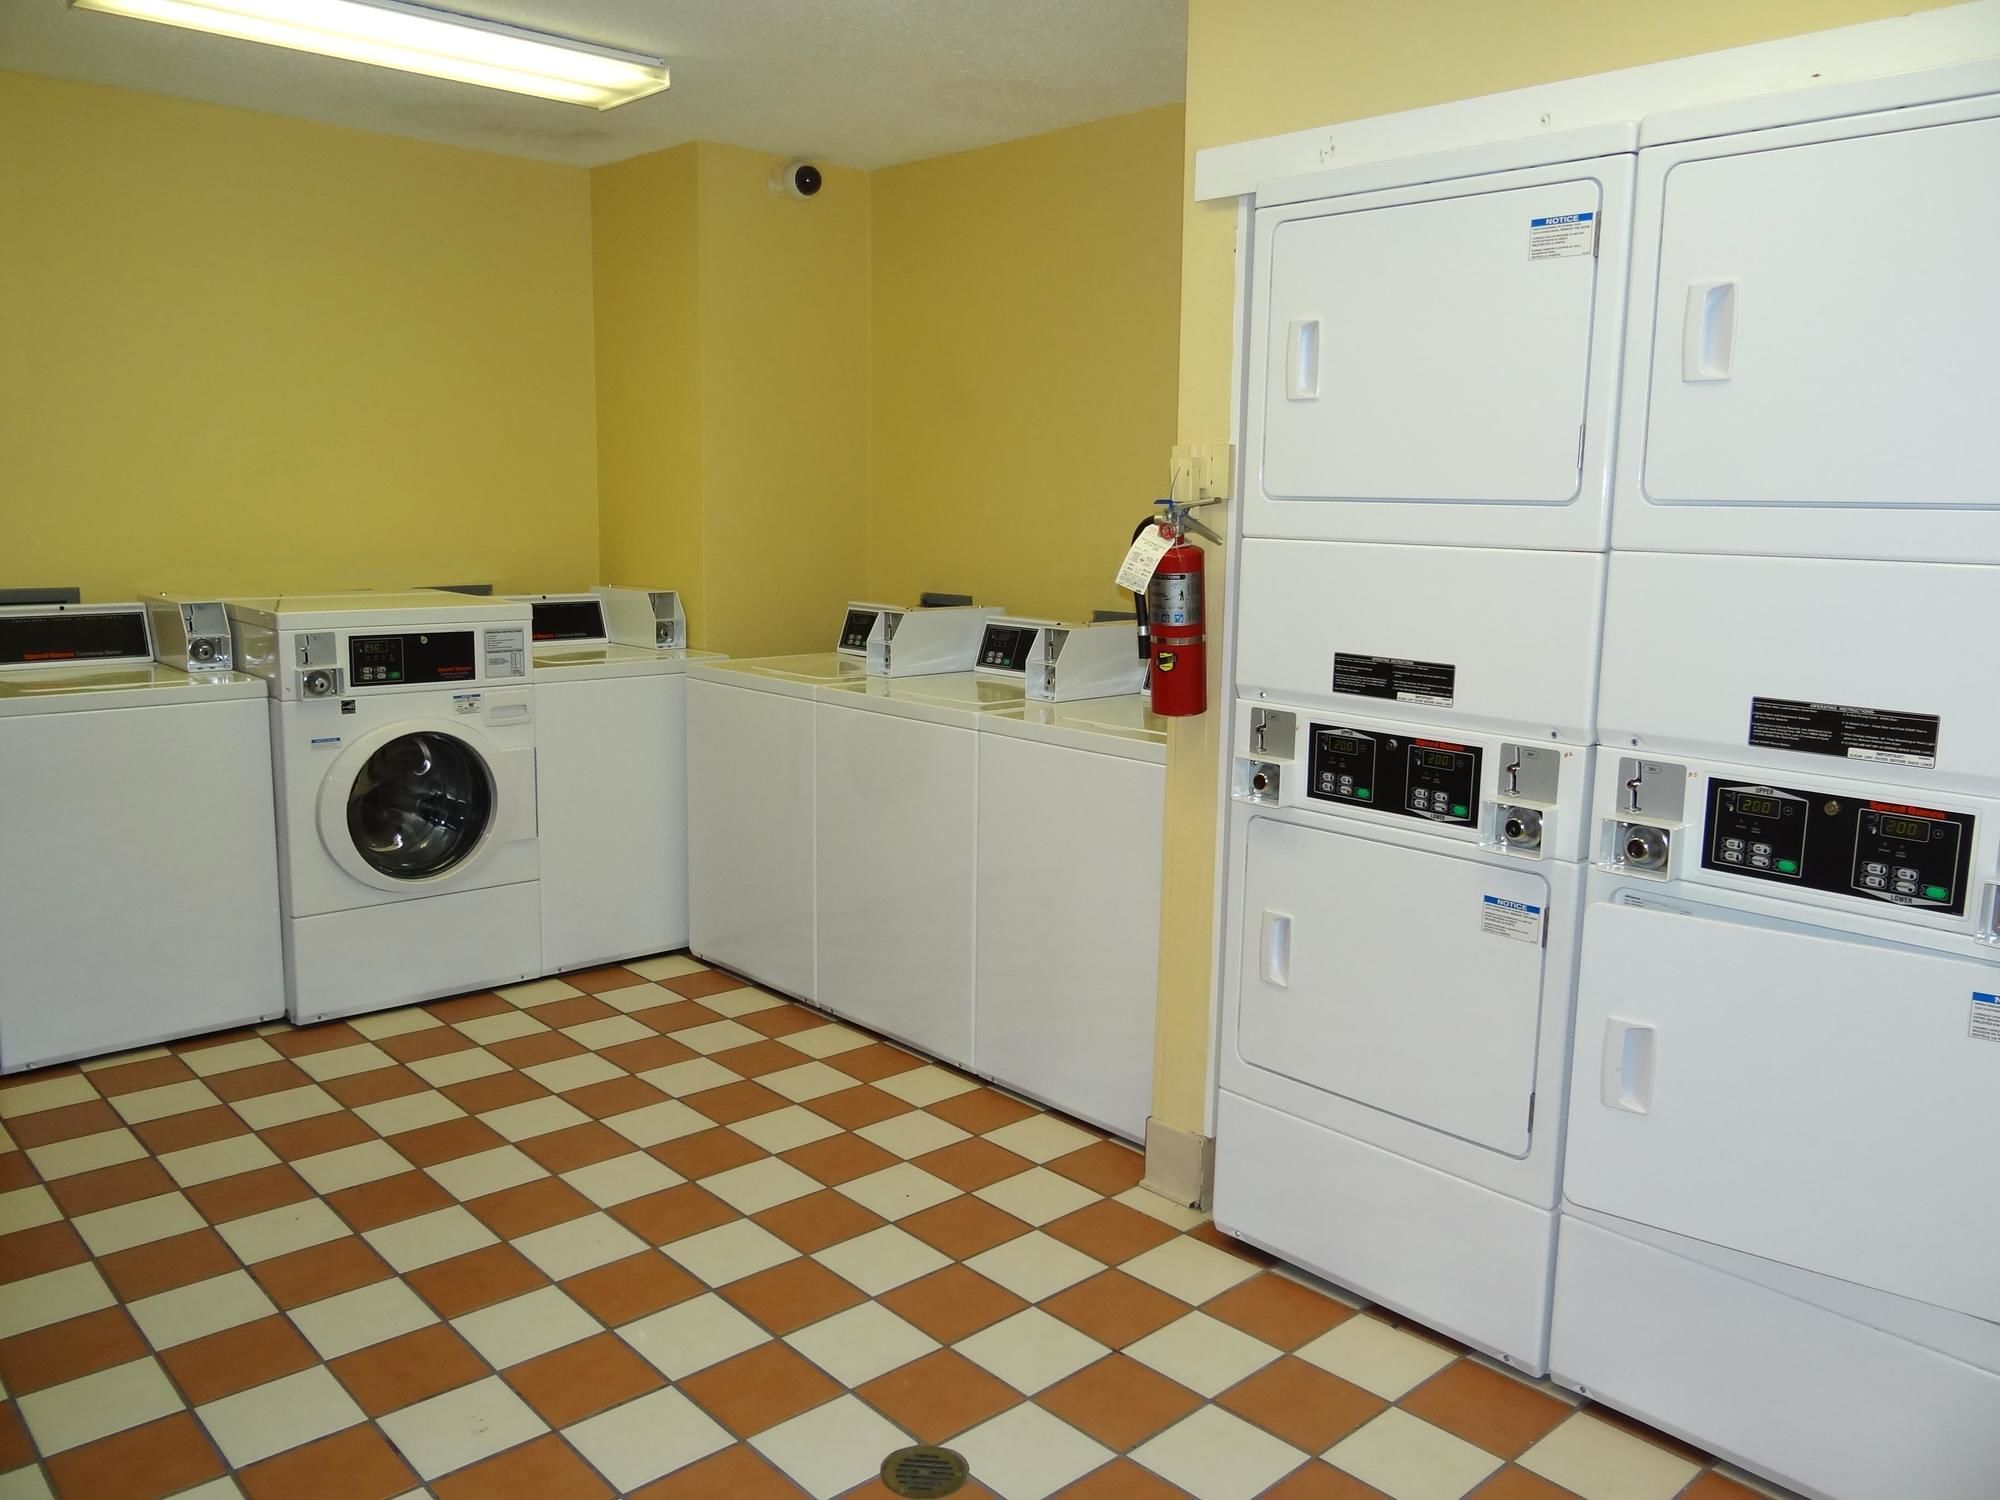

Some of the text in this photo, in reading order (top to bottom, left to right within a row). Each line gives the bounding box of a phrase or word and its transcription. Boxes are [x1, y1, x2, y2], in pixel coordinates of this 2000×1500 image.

[1545, 215, 1580, 225] NOTICE
[1755, 787, 1774, 796] UPPER
[1742, 799, 1771, 814] 200
[1886, 820, 1918, 836] 200
[1496, 899, 1528, 911] NOTICE
[1890, 894, 1913, 905] LOWER
